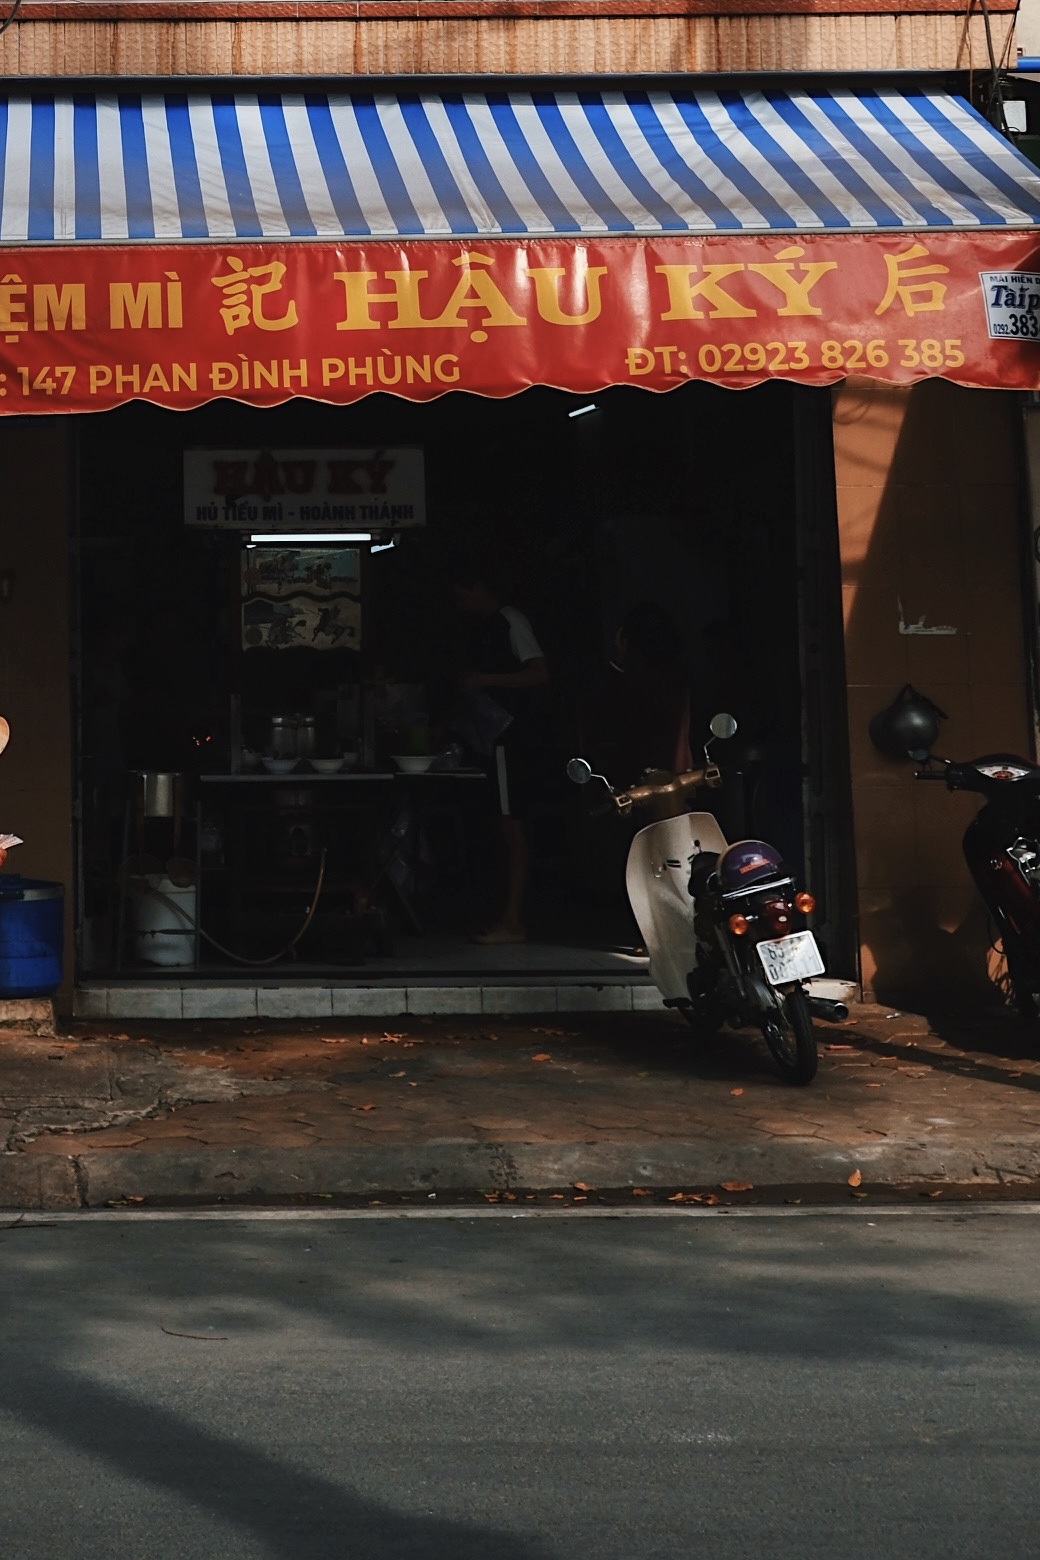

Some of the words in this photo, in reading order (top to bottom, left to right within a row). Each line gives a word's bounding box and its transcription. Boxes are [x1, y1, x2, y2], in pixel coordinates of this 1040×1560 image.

[109, 271, 183, 330] MÌ
[211, 256, 298, 336] 記
[333, 251, 608, 343] HẬU
[655, 246, 838, 322] KÝ
[874, 244, 950, 318] 后
[16, 366, 77, 396] 147
[89, 362, 199, 394] PHAN
[209, 353, 308, 391] ĐÌNH
[322, 348, 461, 387] PHÙNG
[625, 347, 688, 376] ĐT:
[698, 341, 811, 374] 02923
[820, 340, 889, 369] 826
[898, 338, 965, 369] 385
